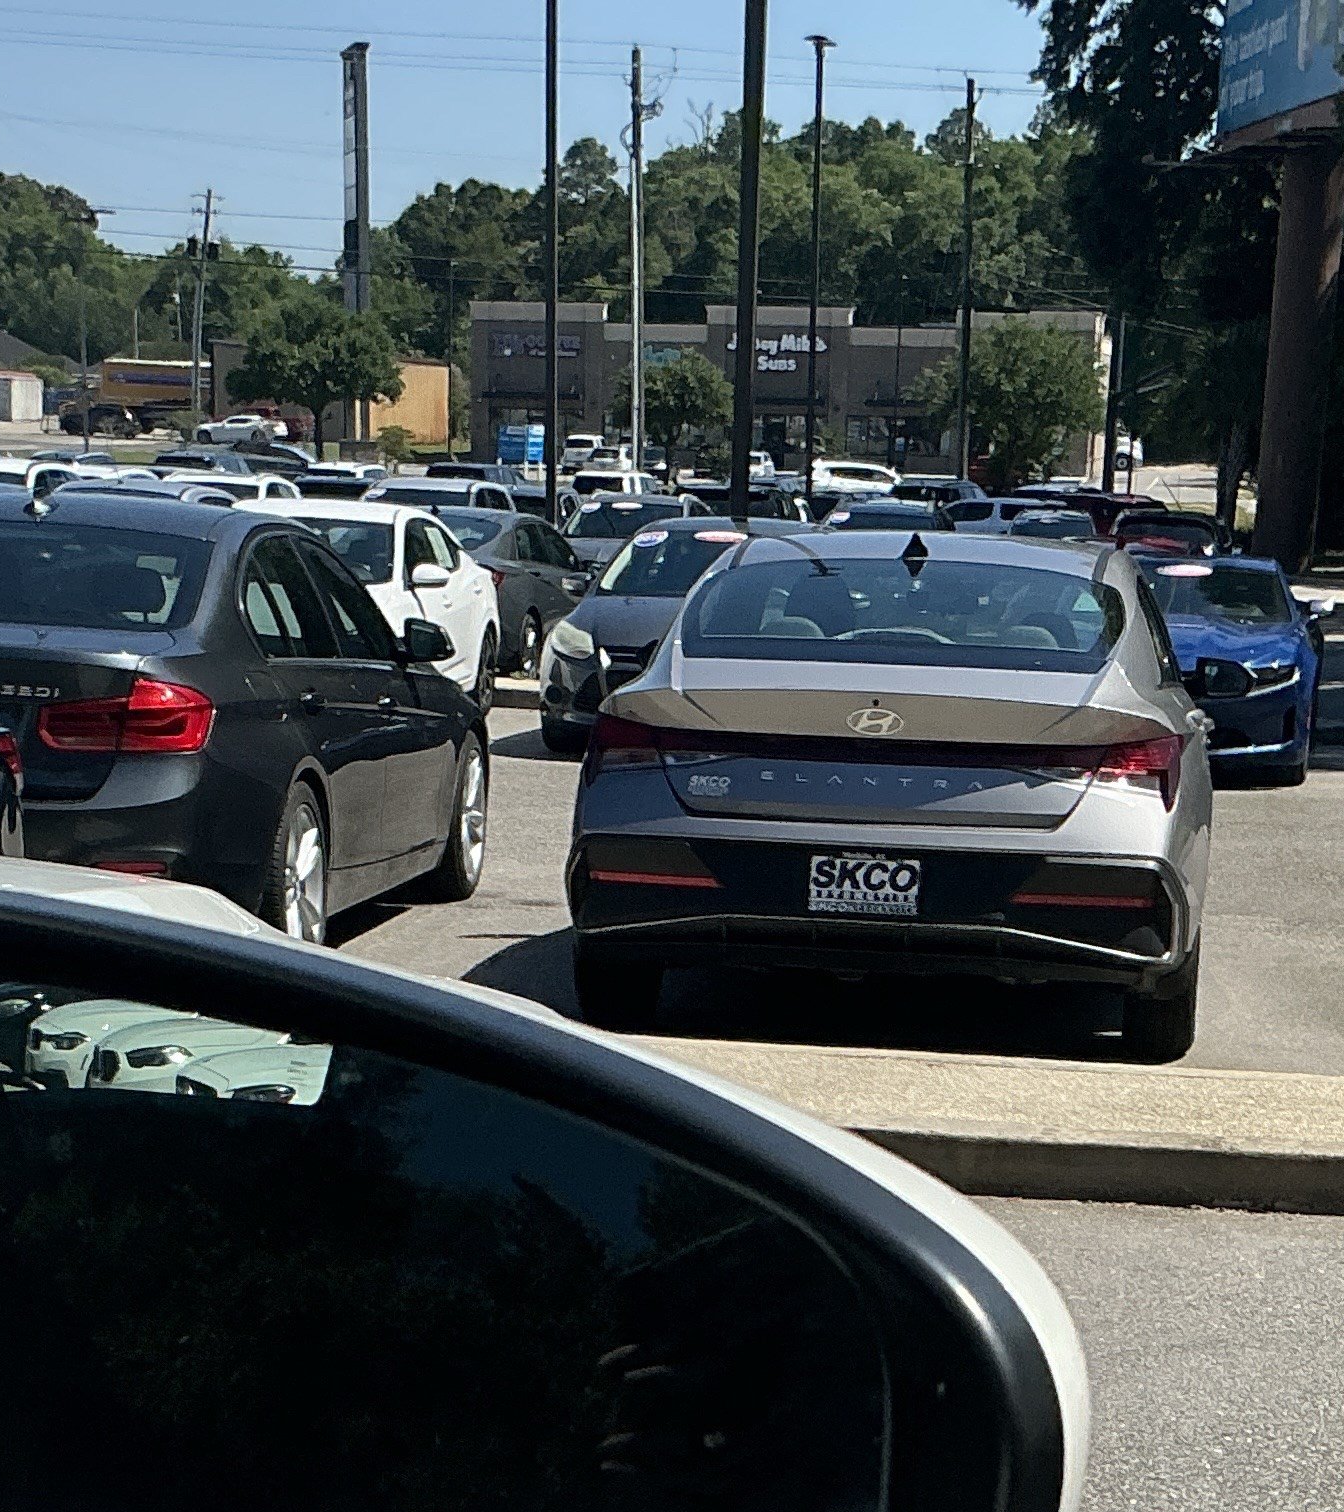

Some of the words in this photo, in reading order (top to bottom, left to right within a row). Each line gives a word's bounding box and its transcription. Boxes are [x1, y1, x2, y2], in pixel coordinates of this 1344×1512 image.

[688, 774, 731, 788] SKCO
[759, 768, 983, 790] ELANTRA
[811, 859, 920, 893] SKCO
